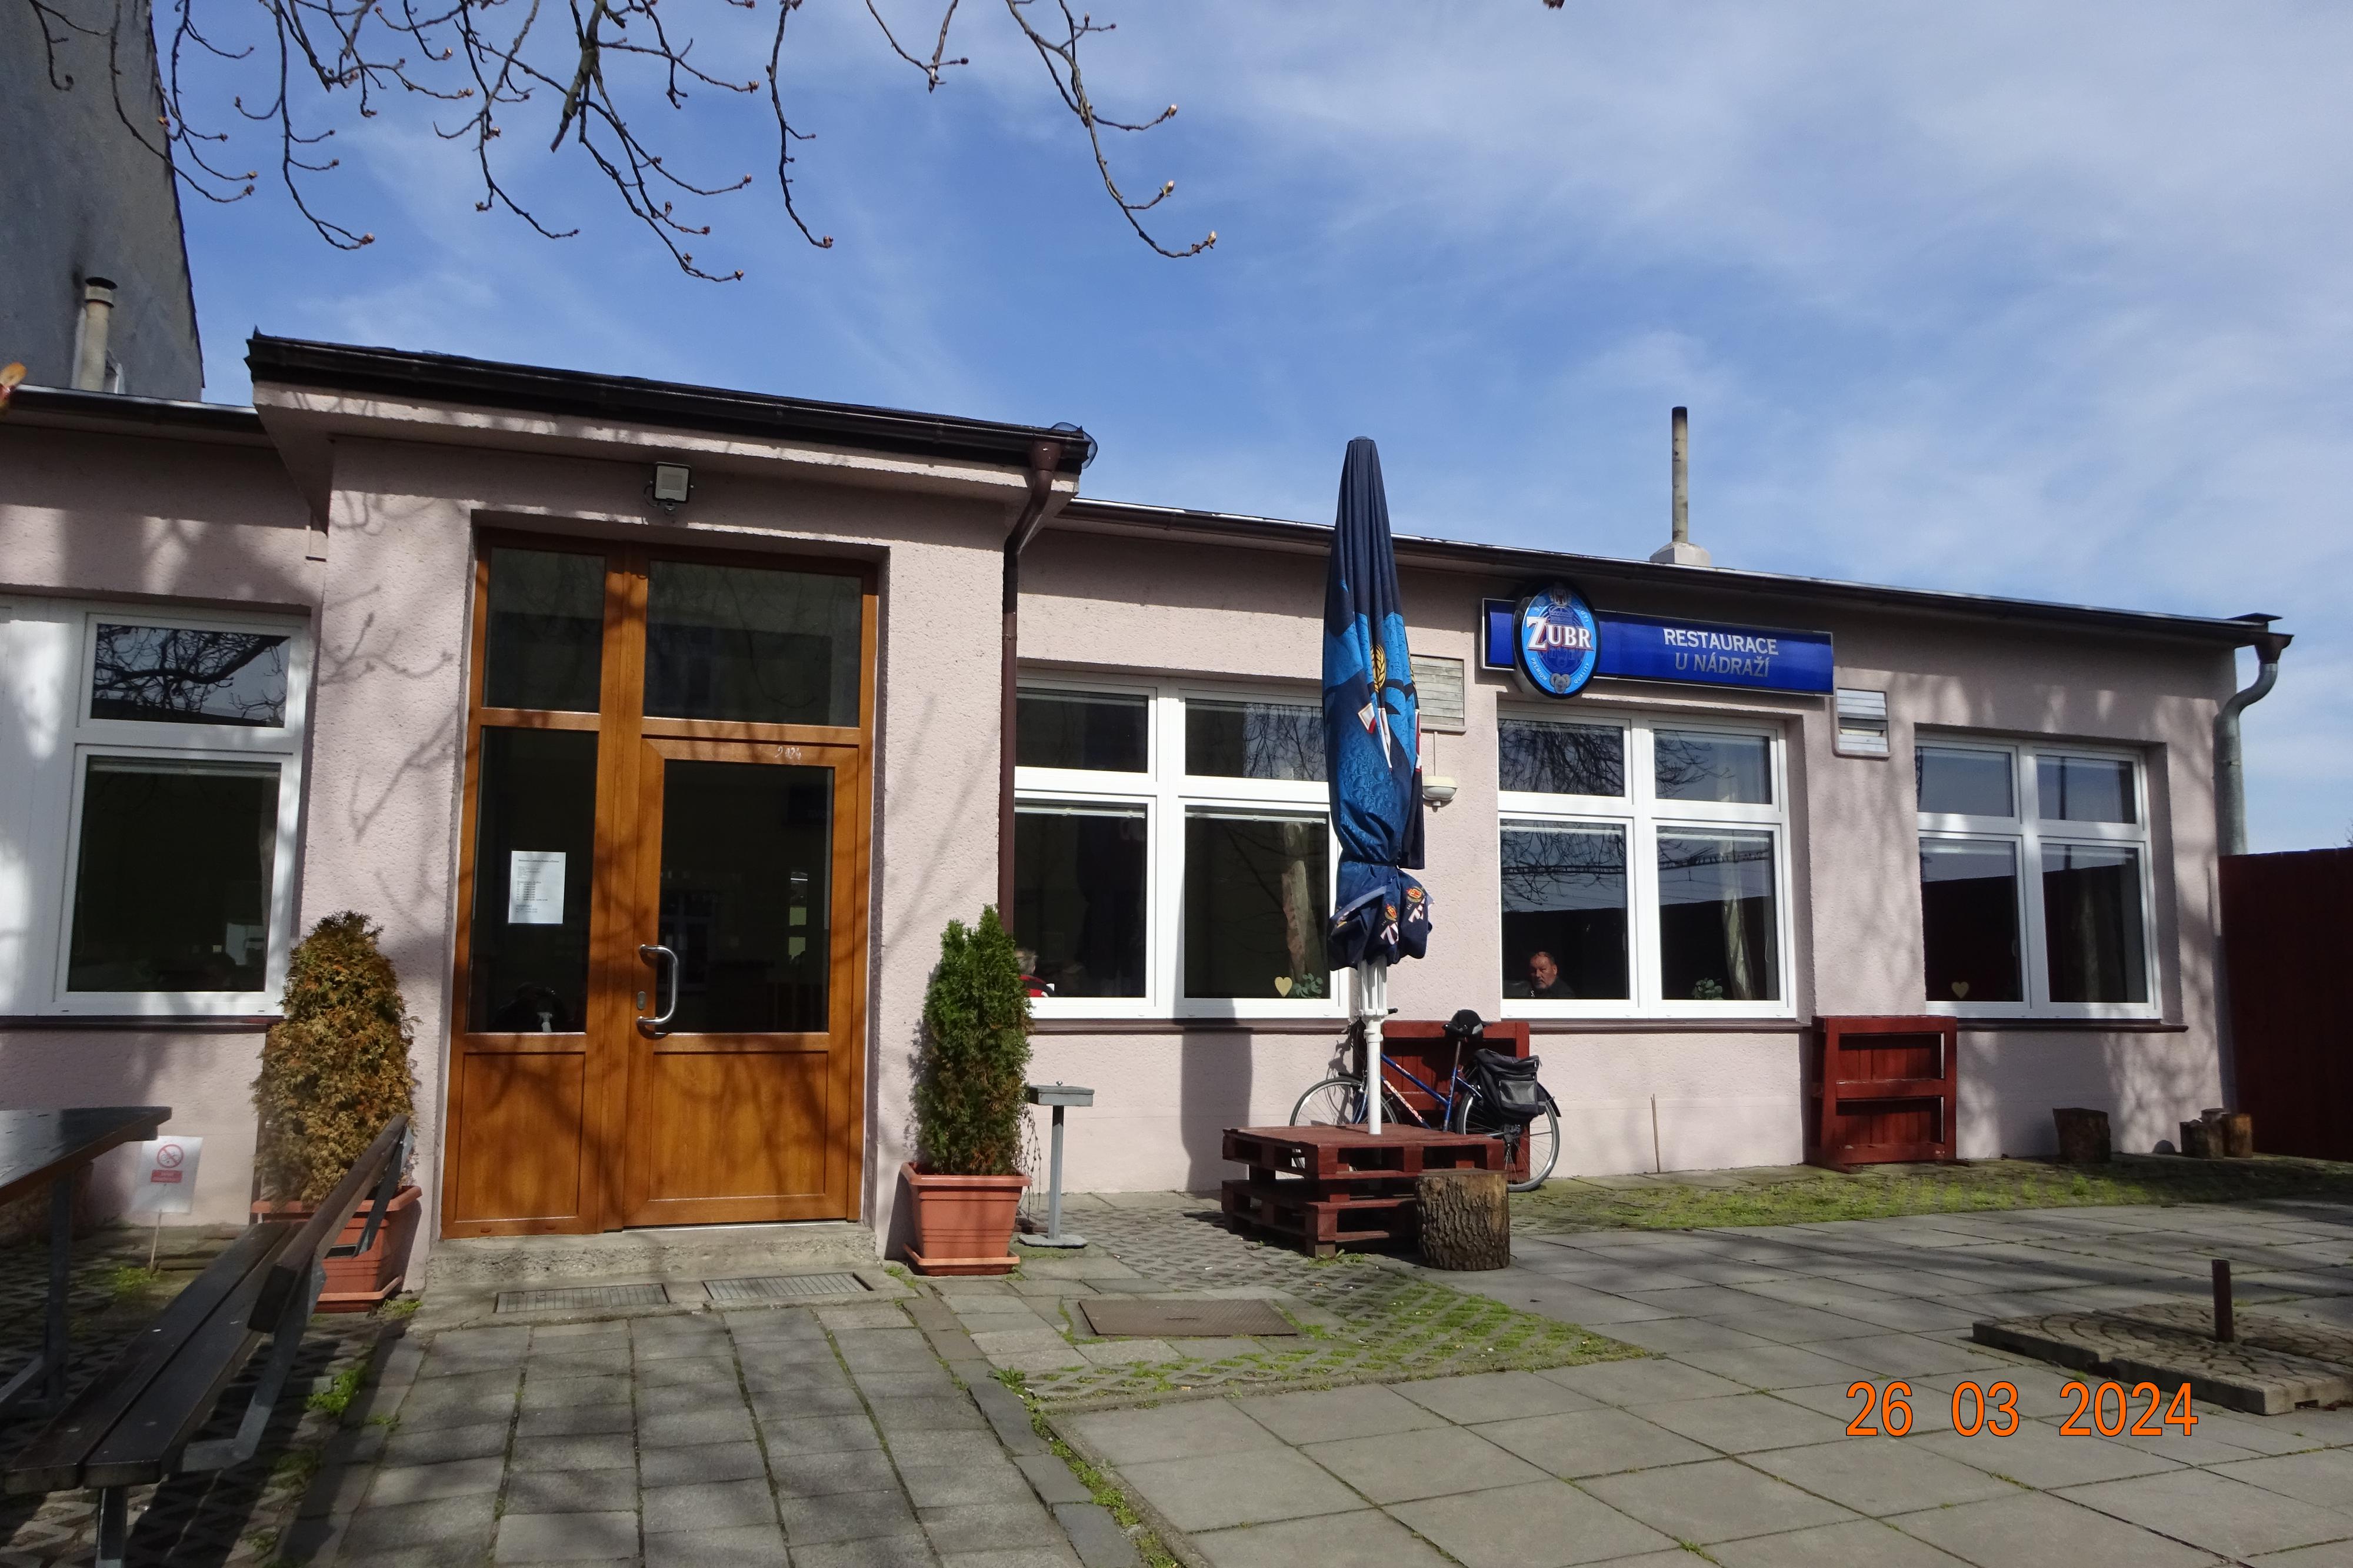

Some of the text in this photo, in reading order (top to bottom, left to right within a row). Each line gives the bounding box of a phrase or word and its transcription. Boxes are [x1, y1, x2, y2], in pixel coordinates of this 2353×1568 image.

[1527, 617, 1594, 651] ZUBR
[1663, 628, 1779, 655] RESTAURACE
[1531, 658, 1548, 680] PREMIUM
[1574, 663, 1589, 685] QUALITY
[1675, 652, 1769, 678] U NÁDRAŽÍ
